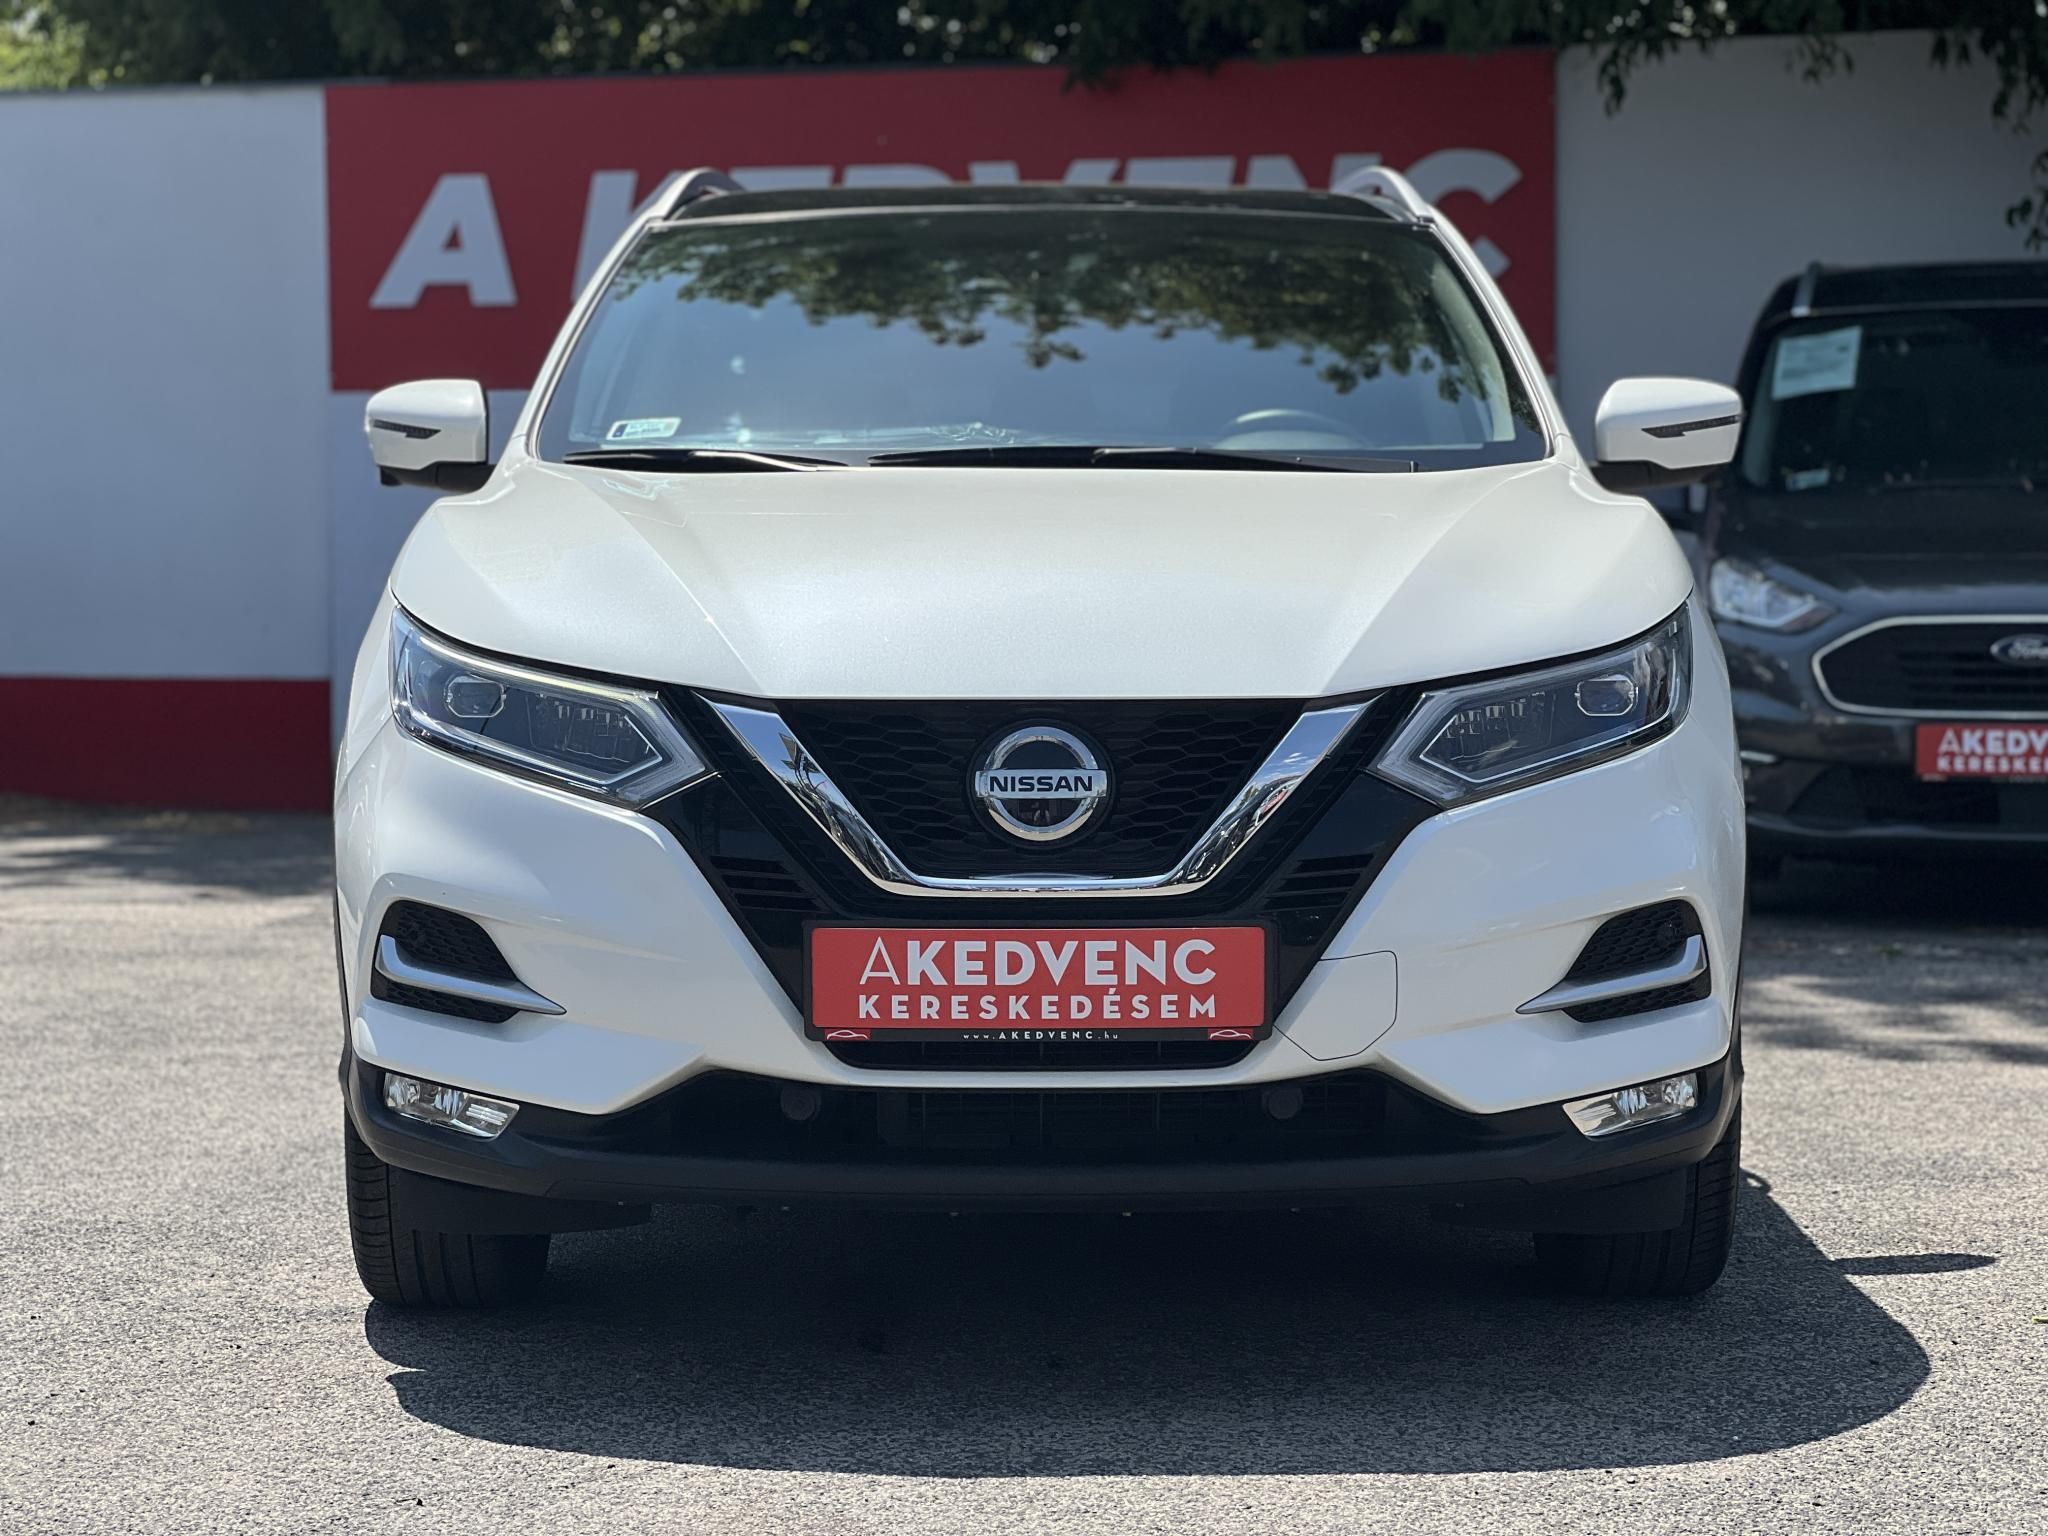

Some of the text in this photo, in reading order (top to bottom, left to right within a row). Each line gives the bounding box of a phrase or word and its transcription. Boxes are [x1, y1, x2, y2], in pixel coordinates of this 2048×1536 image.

[370, 173, 517, 308] A
[1936, 755, 2048, 773] KERESKE
[989, 775, 1093, 792] NISSAN
[859, 935, 1217, 987] AKEDVENC
[858, 987, 1217, 1020] KERESKEDÉSEM
